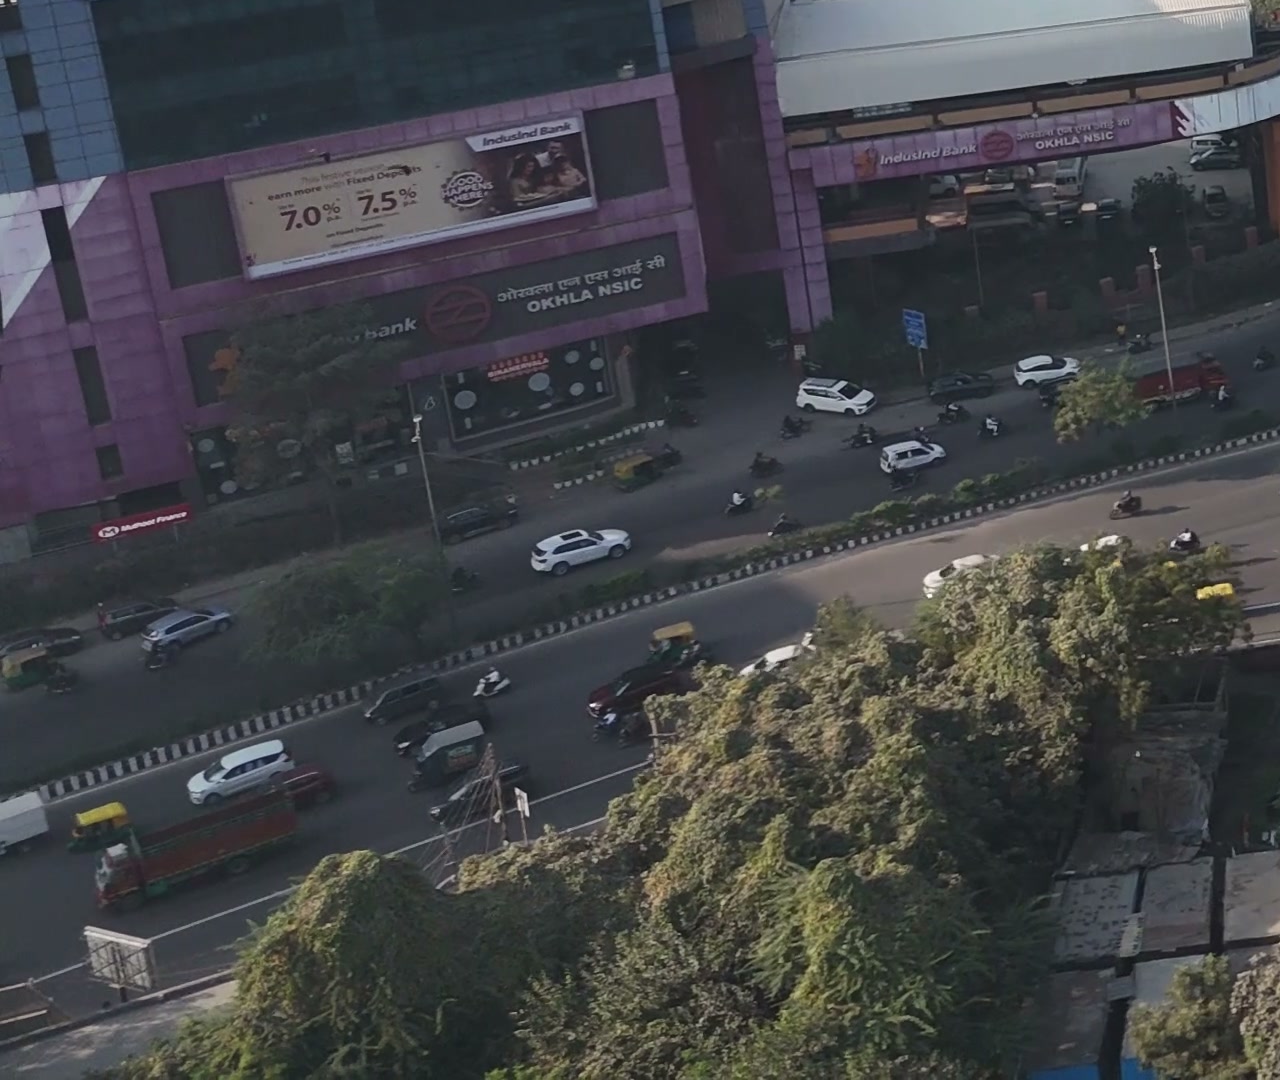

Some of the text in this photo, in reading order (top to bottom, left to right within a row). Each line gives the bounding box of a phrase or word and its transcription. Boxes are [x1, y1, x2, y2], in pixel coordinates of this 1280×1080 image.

[482, 122, 572, 147] IndusInd Bank
[1034, 130, 1114, 150] OKHLA NSIC
[880, 143, 977, 166] IndusInd Bank
[267, 191, 292, 201] earn
[294, 185, 322, 196] more
[346, 173, 374, 186] Fixed
[441, 181, 495, 200] HAPPENS
[448, 175, 484, 189] GOOD
[557, 276, 581, 291] एन
[583, 270, 609, 285] एस
[612, 259, 643, 277] आई
[646, 254, 666, 270] सी
[526, 277, 643, 313] OKHLA NSIC
